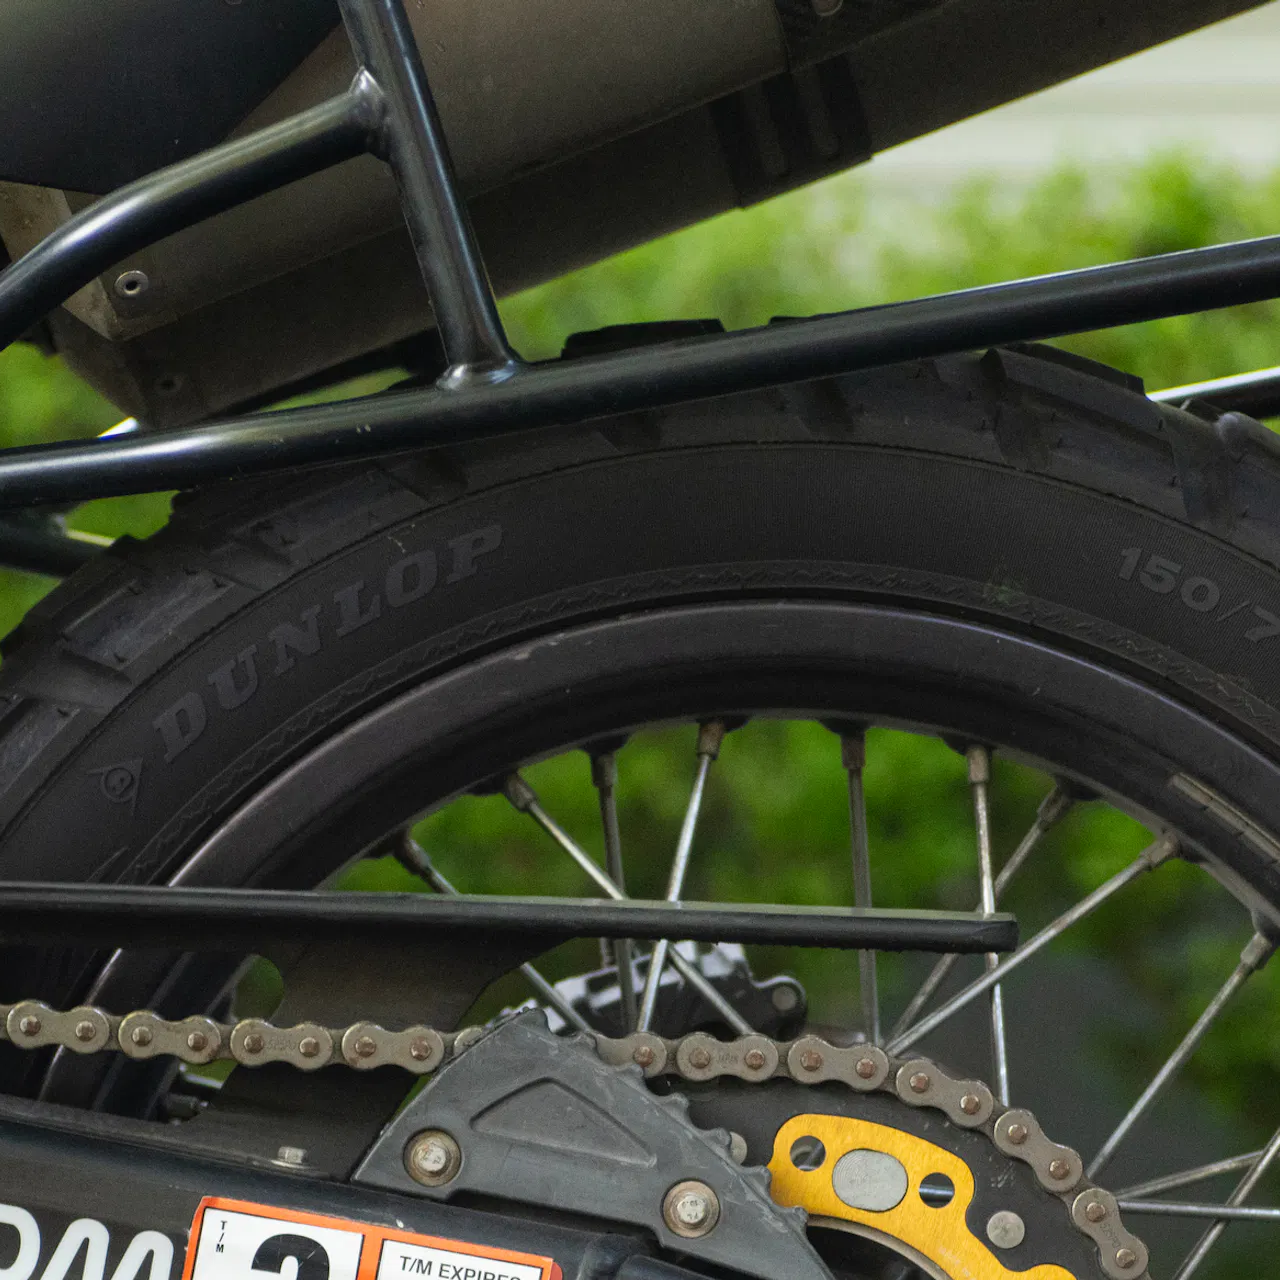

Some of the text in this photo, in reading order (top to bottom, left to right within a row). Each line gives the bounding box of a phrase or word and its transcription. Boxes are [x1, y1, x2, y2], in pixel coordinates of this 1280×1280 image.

[152, 525, 503, 763] DUNLOP
[215, 1220, 228, 1253] T/M
[399, 1255, 433, 1277] T/M
